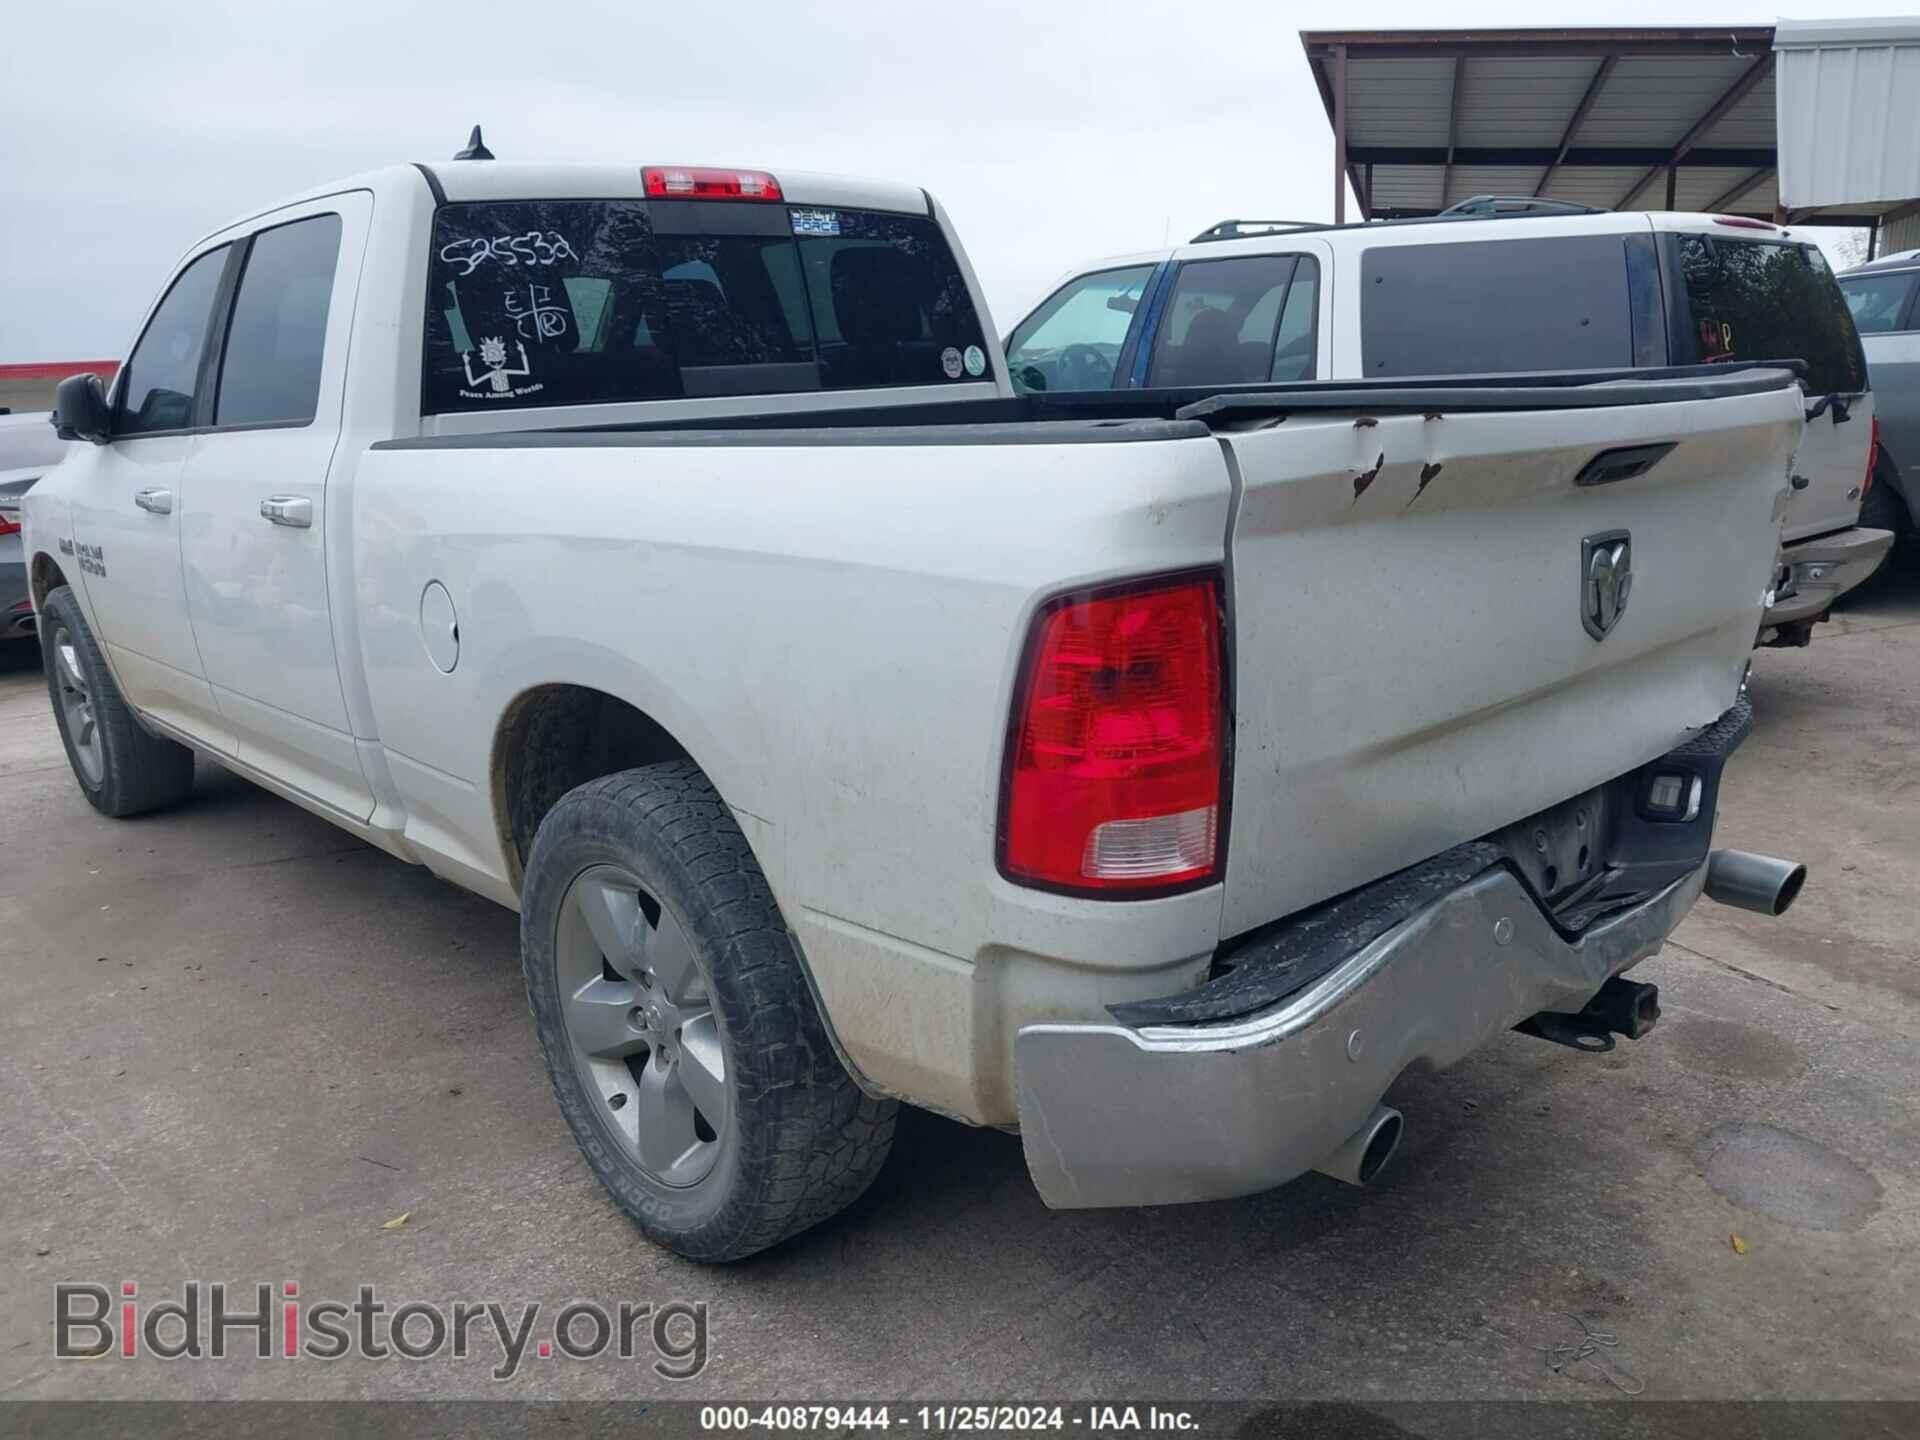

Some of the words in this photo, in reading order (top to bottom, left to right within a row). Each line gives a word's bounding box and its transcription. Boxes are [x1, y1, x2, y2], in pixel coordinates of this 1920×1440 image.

[460, 389, 483, 398] Peace
[485, 391, 515, 399] Among
[515, 383, 544, 395] Worlds
